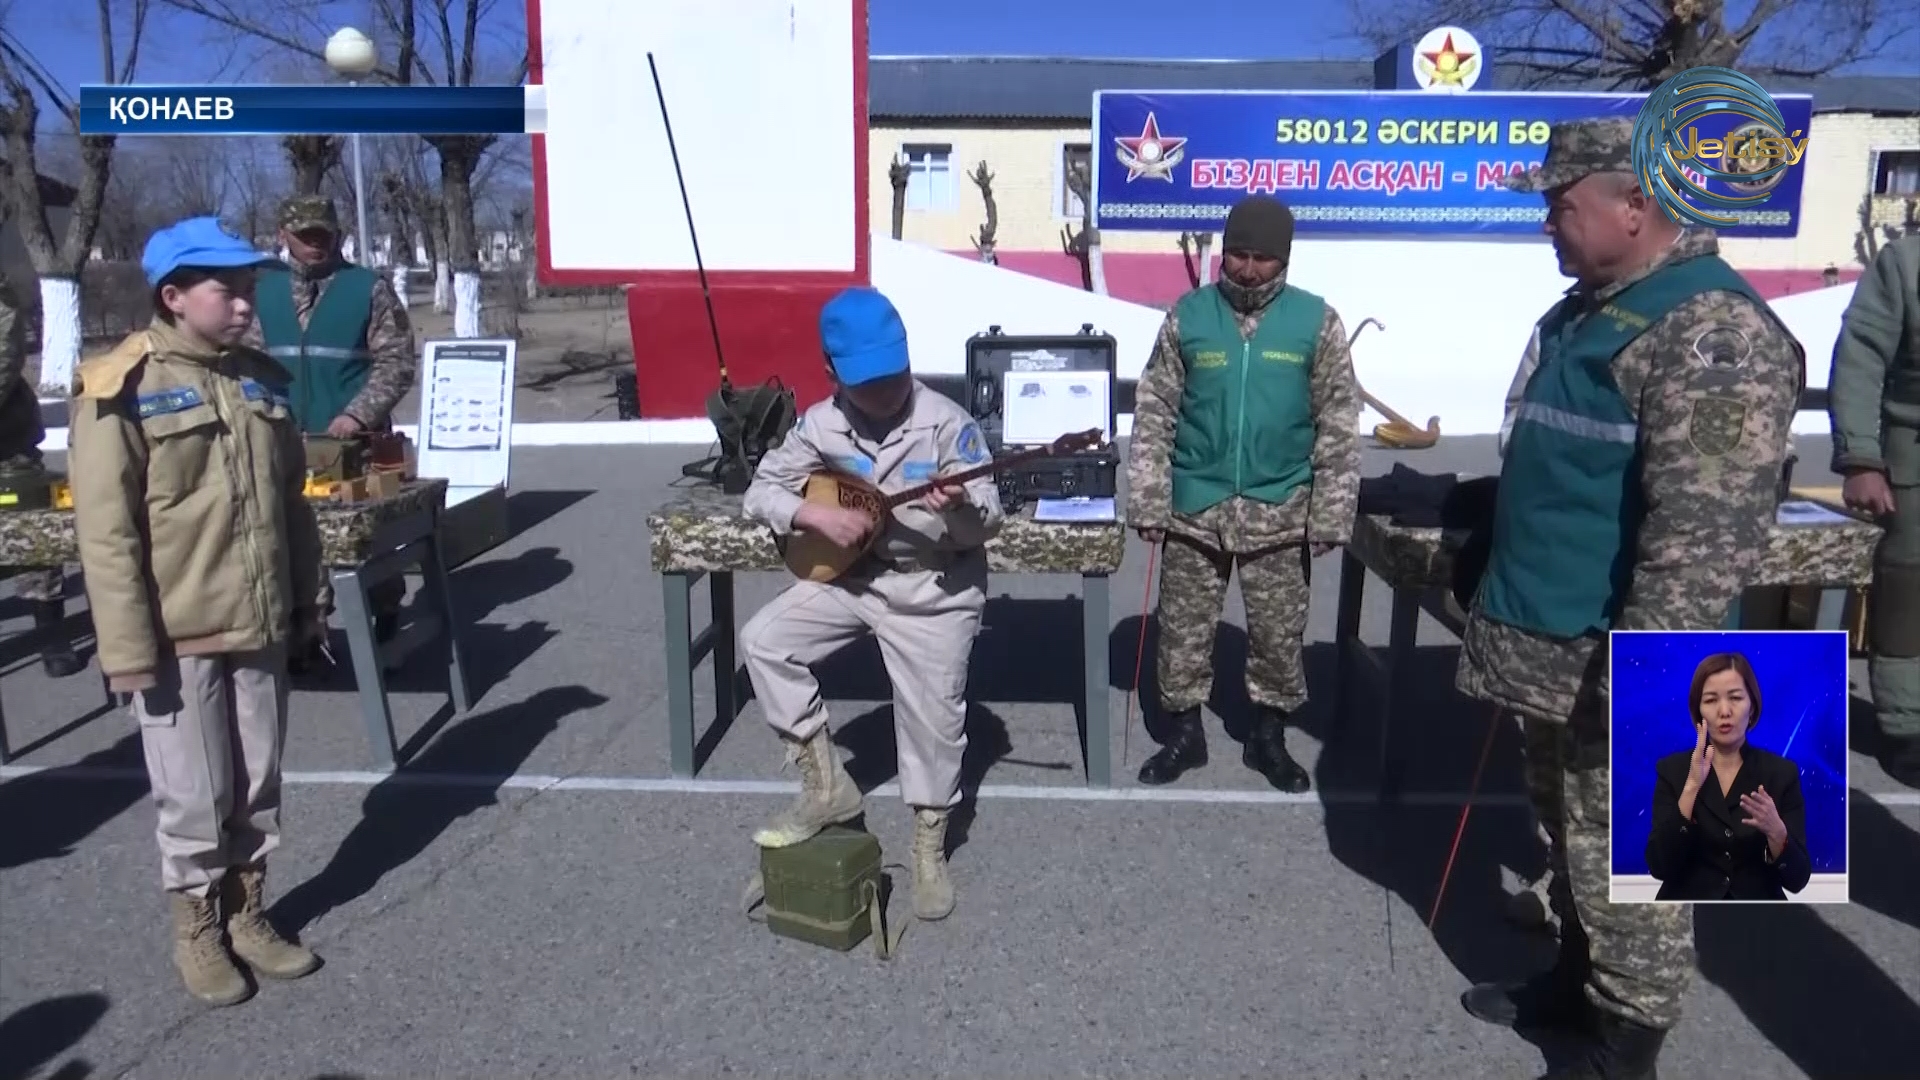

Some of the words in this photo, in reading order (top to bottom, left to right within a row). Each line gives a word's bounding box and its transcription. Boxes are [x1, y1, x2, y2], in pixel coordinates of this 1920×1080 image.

[1276, 118, 1369, 144] 58012
[1377, 120, 1499, 145] ӘСКЕРИ
[1508, 120, 1551, 145] БӨ
[1191, 159, 1321, 195] БІЗДЕН
[1326, 160, 1445, 197] АСҚАН
[1474, 160, 1546, 191] МА
